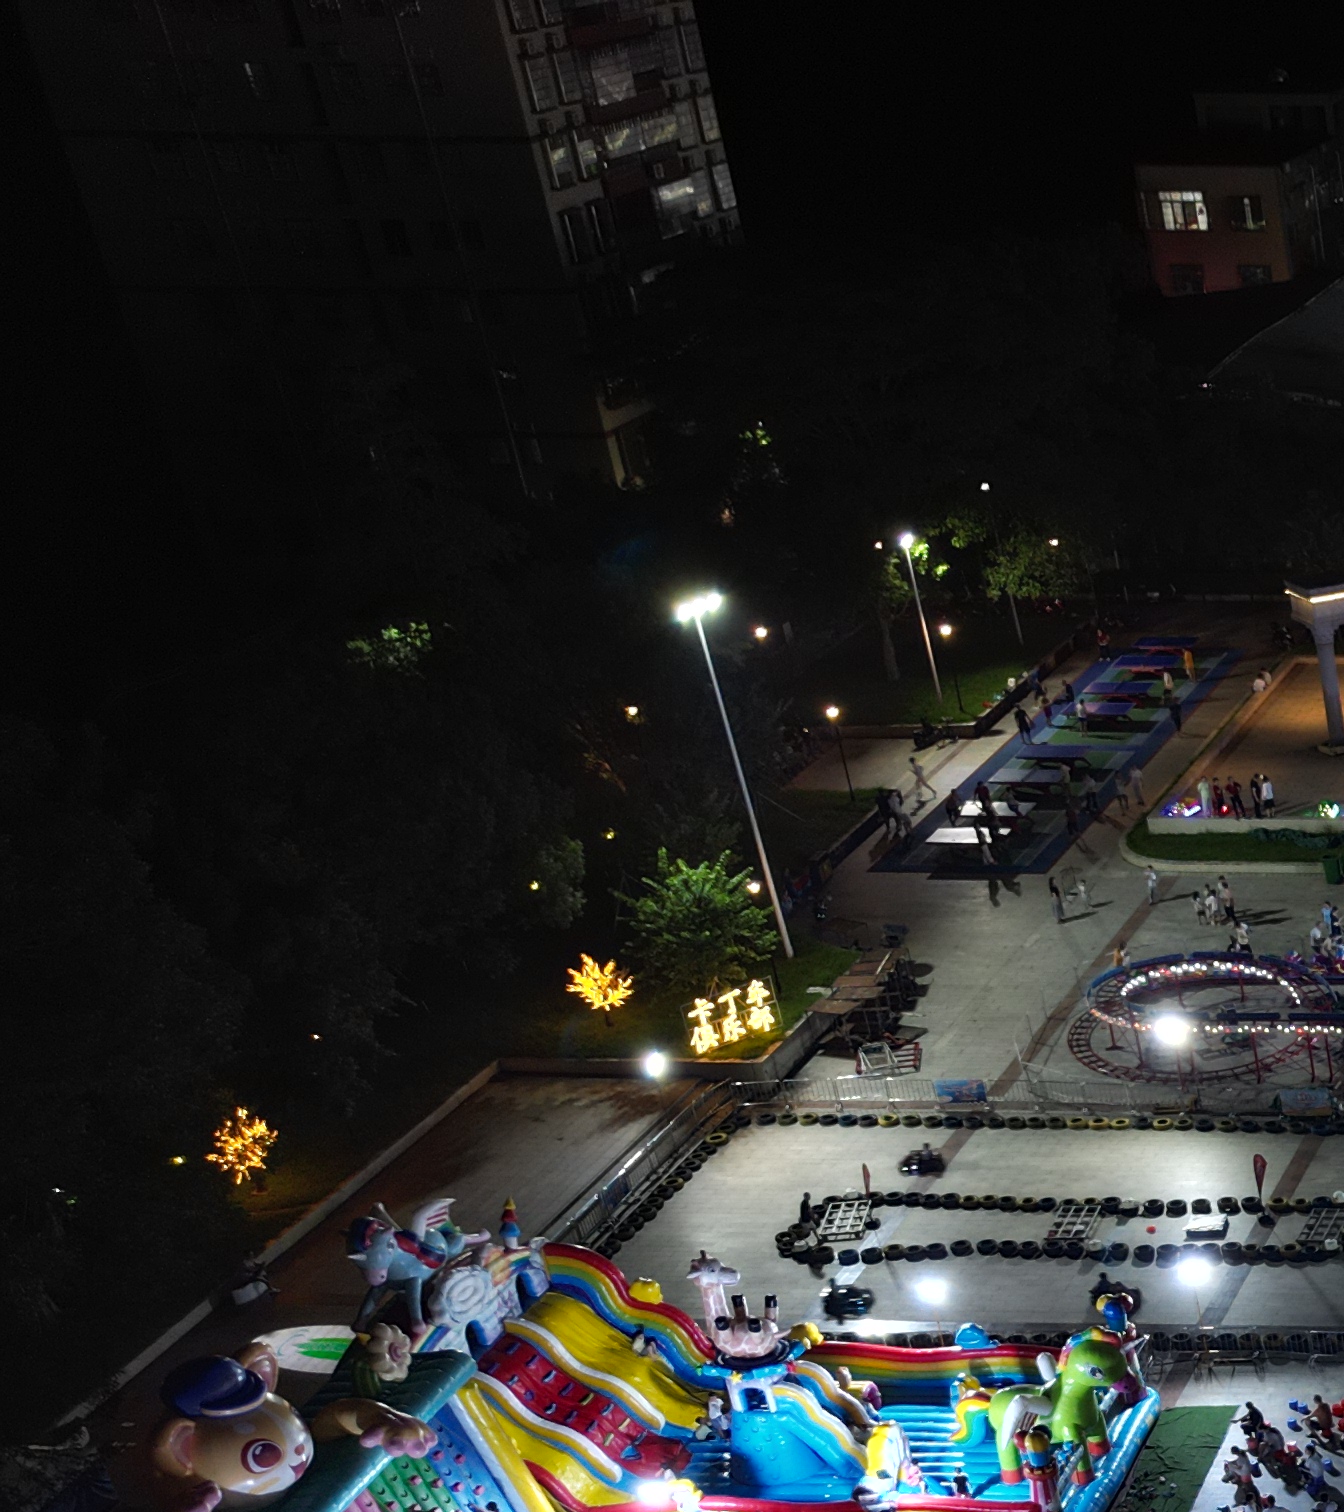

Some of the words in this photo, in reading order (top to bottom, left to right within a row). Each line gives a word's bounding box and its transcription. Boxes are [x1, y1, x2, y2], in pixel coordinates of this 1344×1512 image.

[688, 980, 770, 1026] 卡丁车
[690, 1006, 775, 1054] 俱乐部
